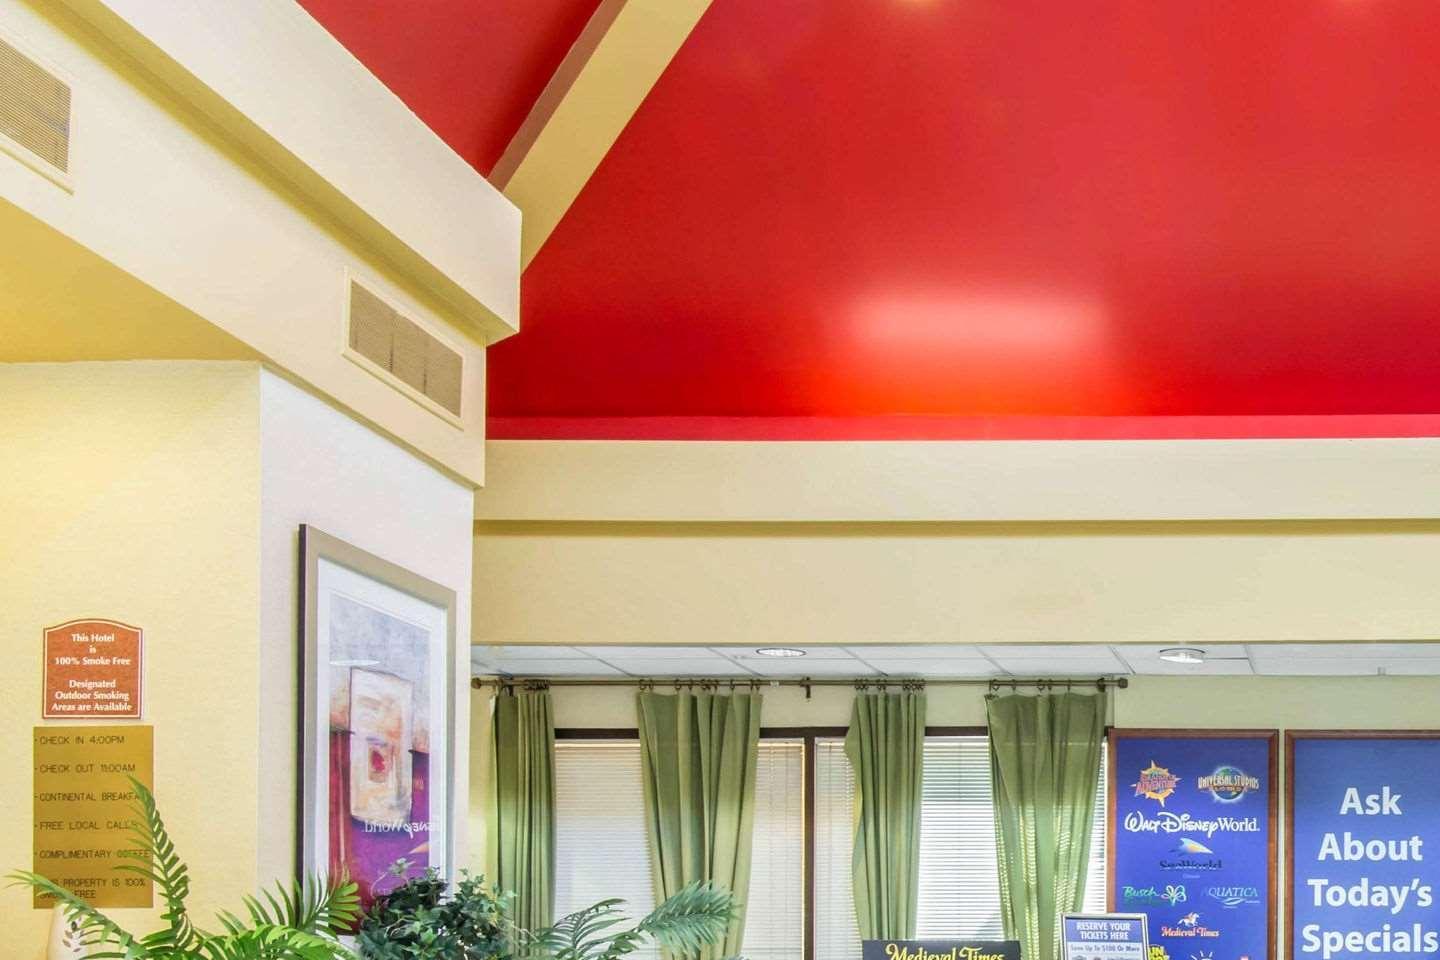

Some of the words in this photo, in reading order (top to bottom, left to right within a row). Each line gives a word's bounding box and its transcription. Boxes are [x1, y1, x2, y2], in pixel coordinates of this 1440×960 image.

[72, 633, 89, 642] This
[91, 633, 115, 642] Hotel
[89, 645, 97, 654] is
[55, 656, 80, 665] 100%
[82, 656, 111, 665] Smoke
[112, 656, 131, 665] Free
[69, 680, 116, 690] Designated
[55, 691, 92, 700] Outdoor
[93, 691, 129, 702] Smoking
[52, 702, 76, 711] Areas
[94, 702, 133, 711] Available
[39, 735, 70, 745] CHECK
[75, 735, 84, 745] IN
[89, 735, 125, 745] 4:00PM
[39, 764, 70, 773] CHECK
[75, 764, 94, 773] OUT
[39, 792, 97, 801] CONTINENTAL
[101, 791, 140, 801] BREAKFA
[1339, 786, 1402, 815] Ask
[39, 820, 65, 830] FREE
[68, 820, 100, 830] LOCAL
[1317, 832, 1423, 861] About
[39, 849, 112, 859] COMPLIMENTARY
[63, 879, 109, 888] PROPERTY
[111, 879, 121, 888] IS
[125, 879, 146, 888] 100%
[74, 889, 97, 899] FREE
[1122, 886, 1161, 898] Busch
[1307, 877, 1432, 915] Today's
[1076, 922, 1108, 931] RESERVE
[1110, 922, 1131, 931] YOUR
[1161, 926, 1196, 937] Medieval
[1196, 927, 1219, 937] Times
[1080, 931, 1109, 940] TICKETS
[1110, 931, 1129, 940] HERE
[1302, 923, 1439, 960] Specials
